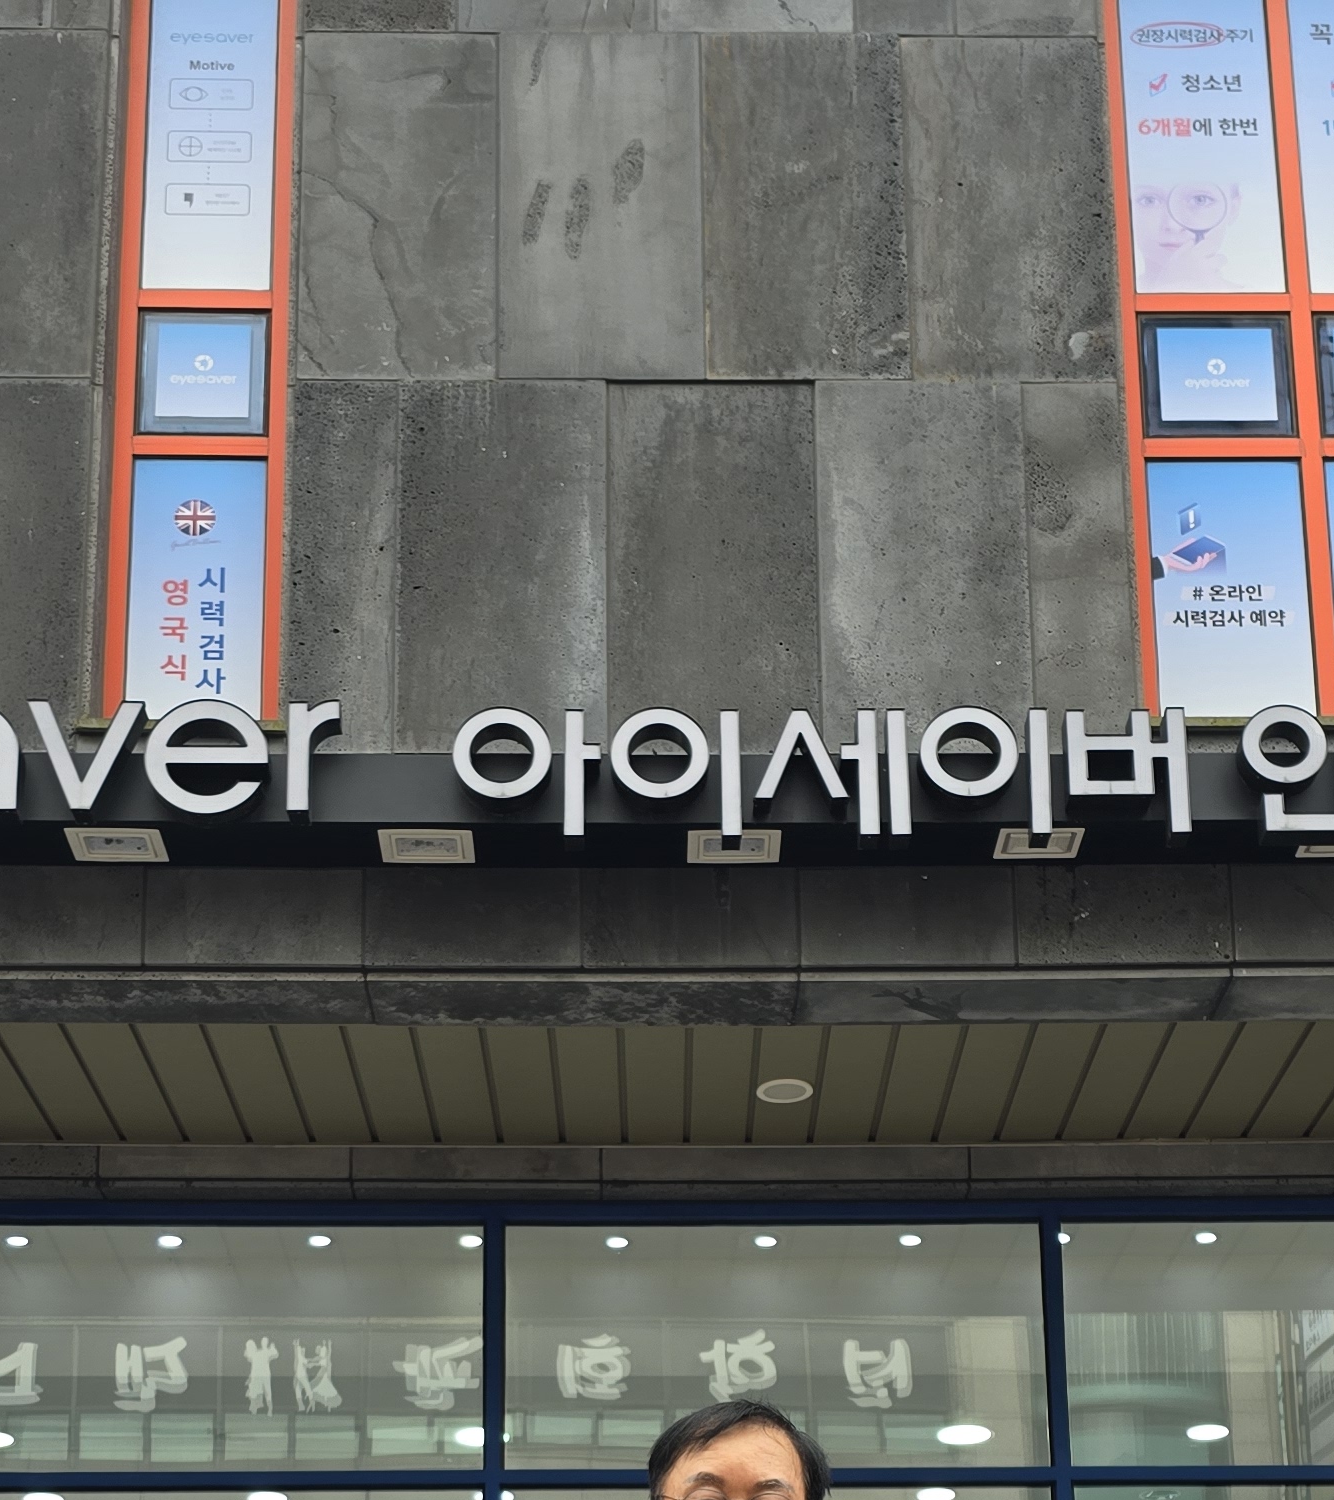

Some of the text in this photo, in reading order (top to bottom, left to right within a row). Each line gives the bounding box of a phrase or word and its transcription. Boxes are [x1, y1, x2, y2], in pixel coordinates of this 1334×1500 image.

[170, 32, 254, 45] eyesaver
[1309, 24, 1333, 45] 꼭
[189, 60, 235, 71] Motive
[1181, 74, 1242, 92] 청소년
[1138, 118, 1259, 137] 6개월에 한번
[169, 373, 237, 386] eyesaver
[1184, 376, 1250, 389] eyesaver
[1209, 584, 1264, 602] 온라인
[1173, 609, 1286, 627] 시력검사 예약
[159, 579, 189, 681] 영국식
[195, 567, 226, 694] 시력검사
[452, 706, 1192, 850] 아이세이버
